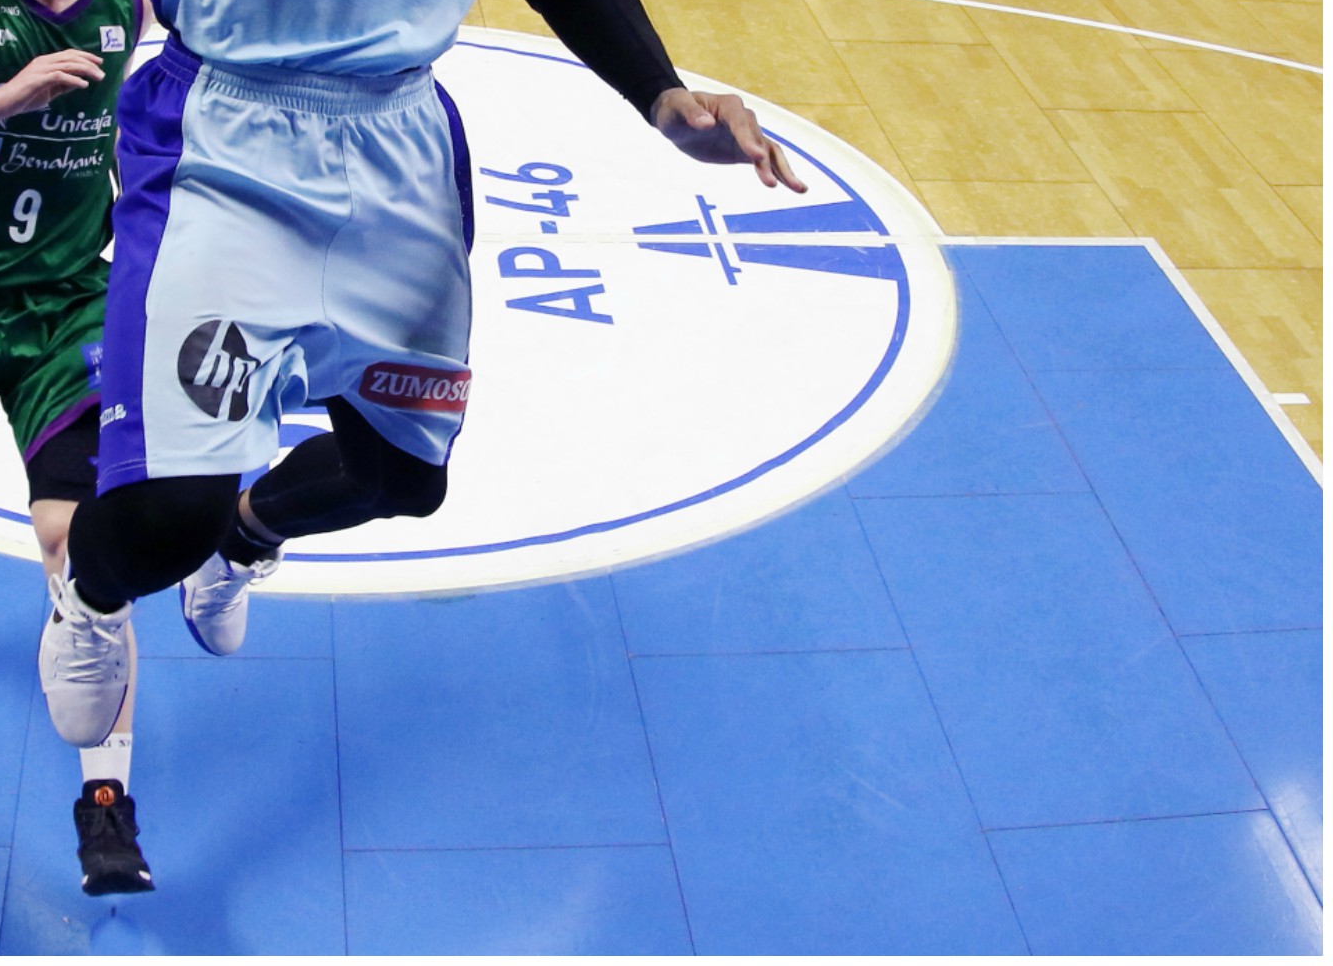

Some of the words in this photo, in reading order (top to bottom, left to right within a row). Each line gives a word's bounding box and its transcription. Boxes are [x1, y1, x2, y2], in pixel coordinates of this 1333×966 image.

[41, 109, 113, 134] Unicaja
[8, 188, 43, 244] 9
[479, 161, 615, 325] AP-46
